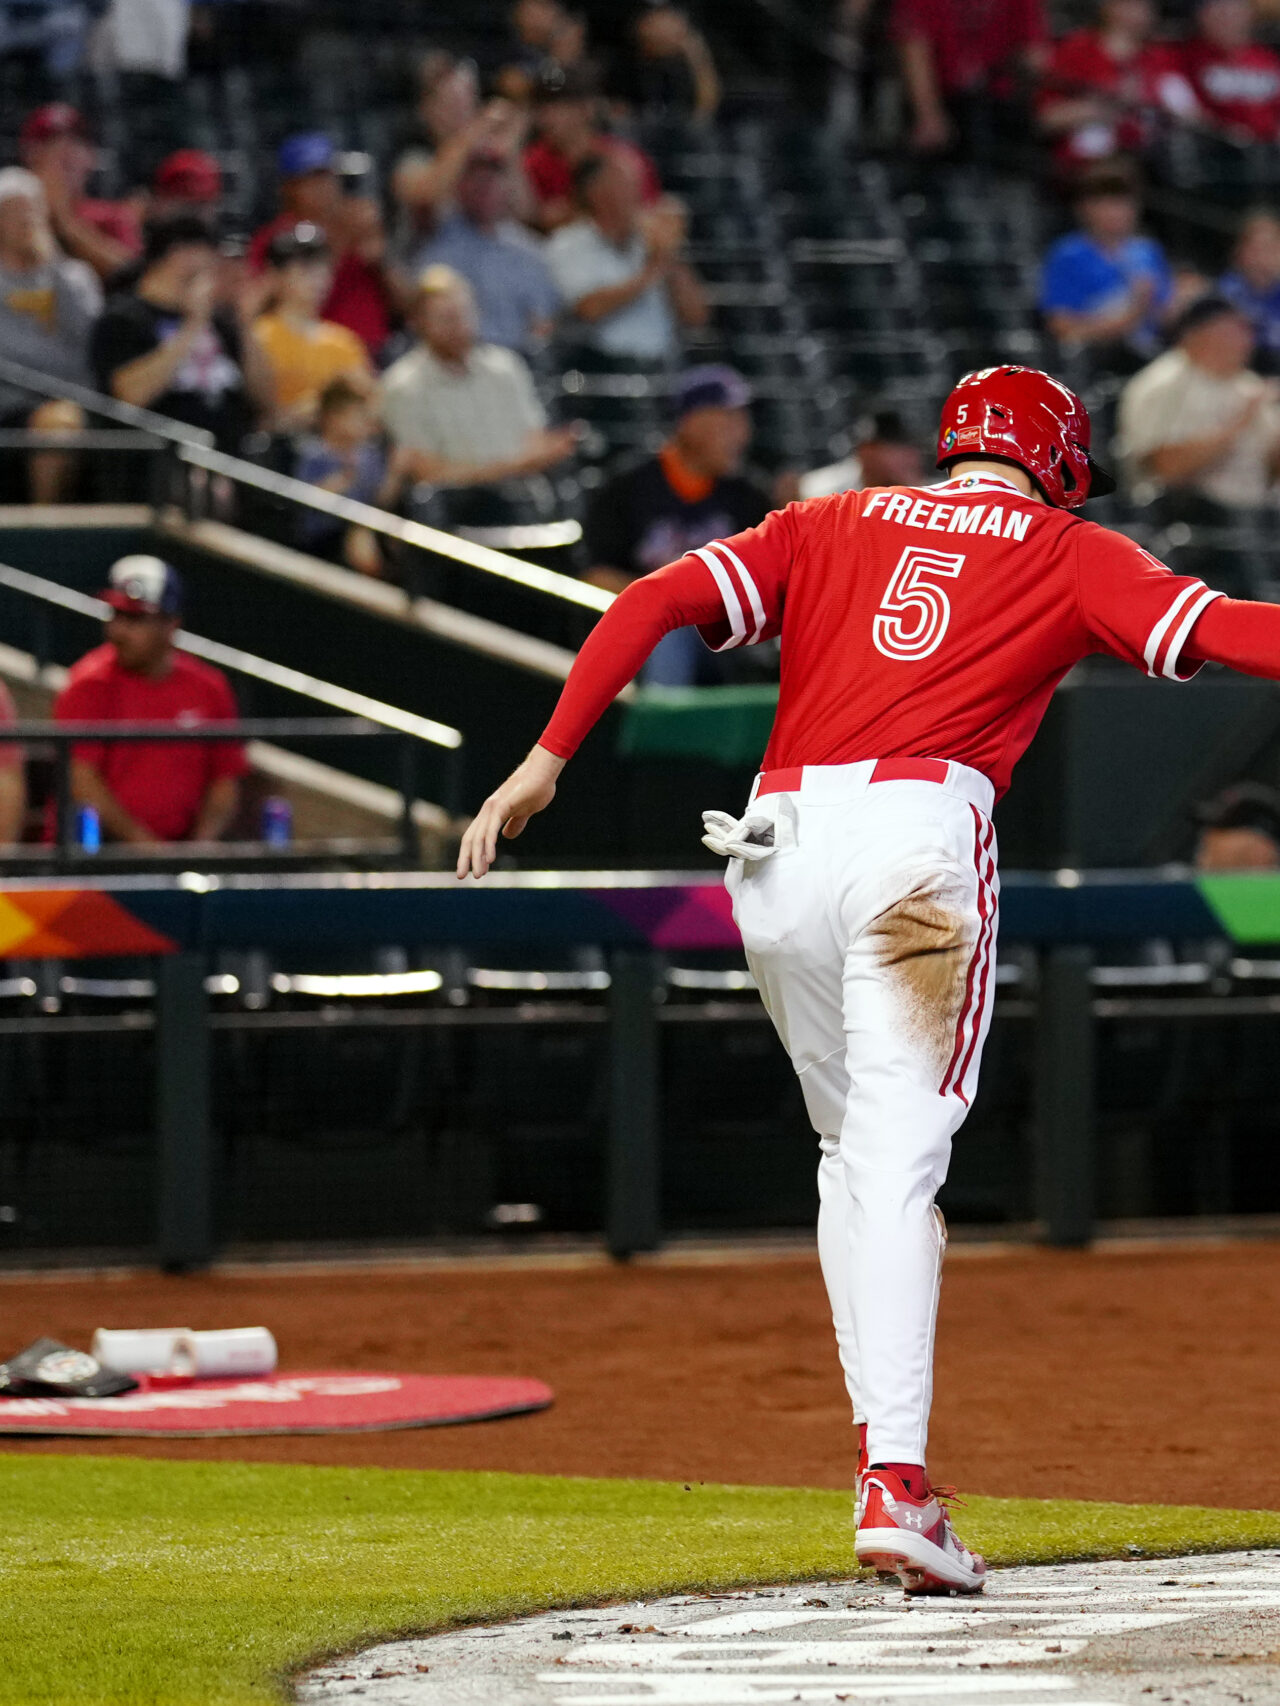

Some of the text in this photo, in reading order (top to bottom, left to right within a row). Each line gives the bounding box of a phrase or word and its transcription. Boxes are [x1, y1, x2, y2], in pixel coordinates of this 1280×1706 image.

[956, 403, 969, 425] 5
[862, 493, 1033, 542] FREEMAN
[872, 546, 966, 661] 5
